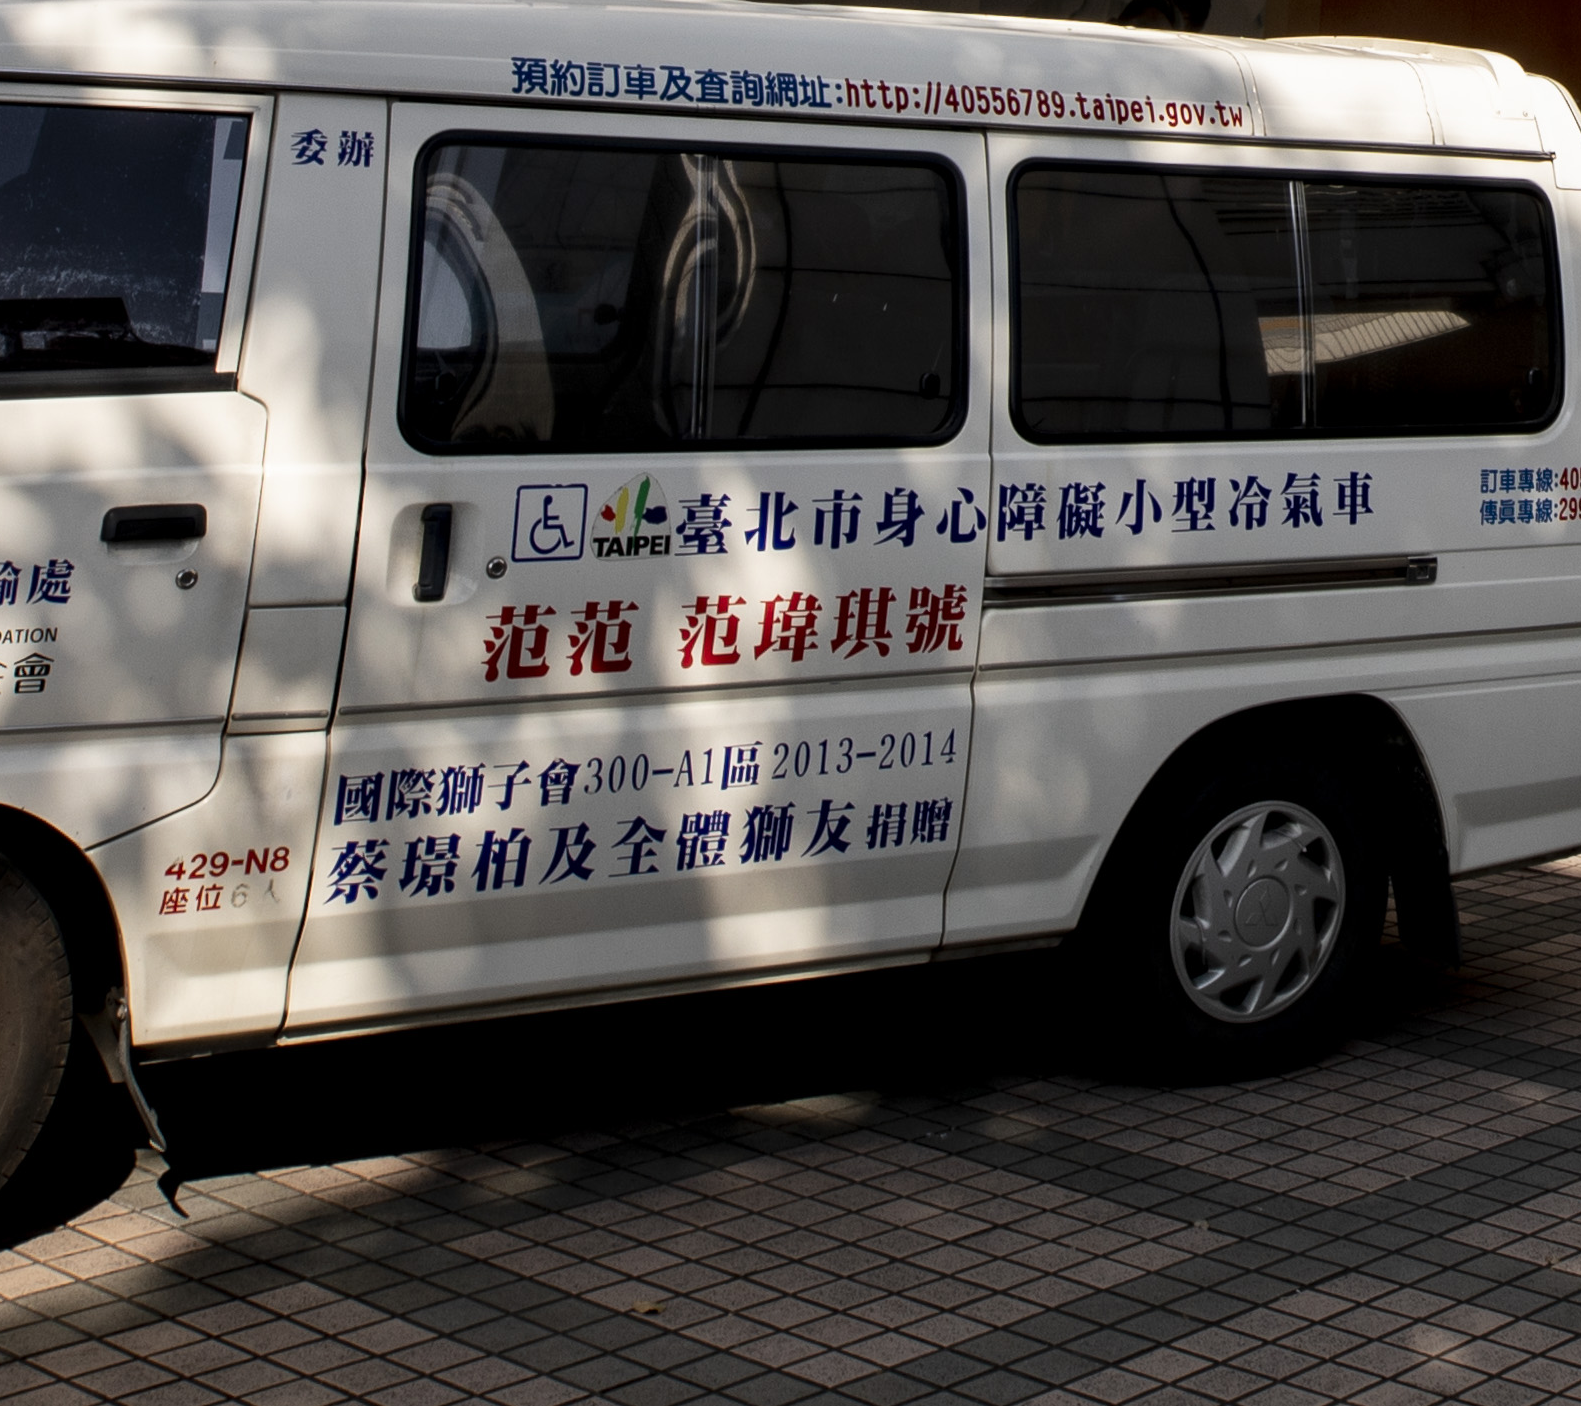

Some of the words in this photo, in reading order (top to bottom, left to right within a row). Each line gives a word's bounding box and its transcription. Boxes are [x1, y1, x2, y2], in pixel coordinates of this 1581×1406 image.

[290, 129, 375, 167] 委辦
[674, 471, 1375, 556] 臺北市身心障礙小型冷氣車
[591, 534, 672, 557] TAIPEI
[480, 600, 640, 683] 范范
[677, 583, 969, 670] 范瑋琪號
[771, 728, 959, 781] 2013-2014
[164, 846, 290, 881] 429-N8
